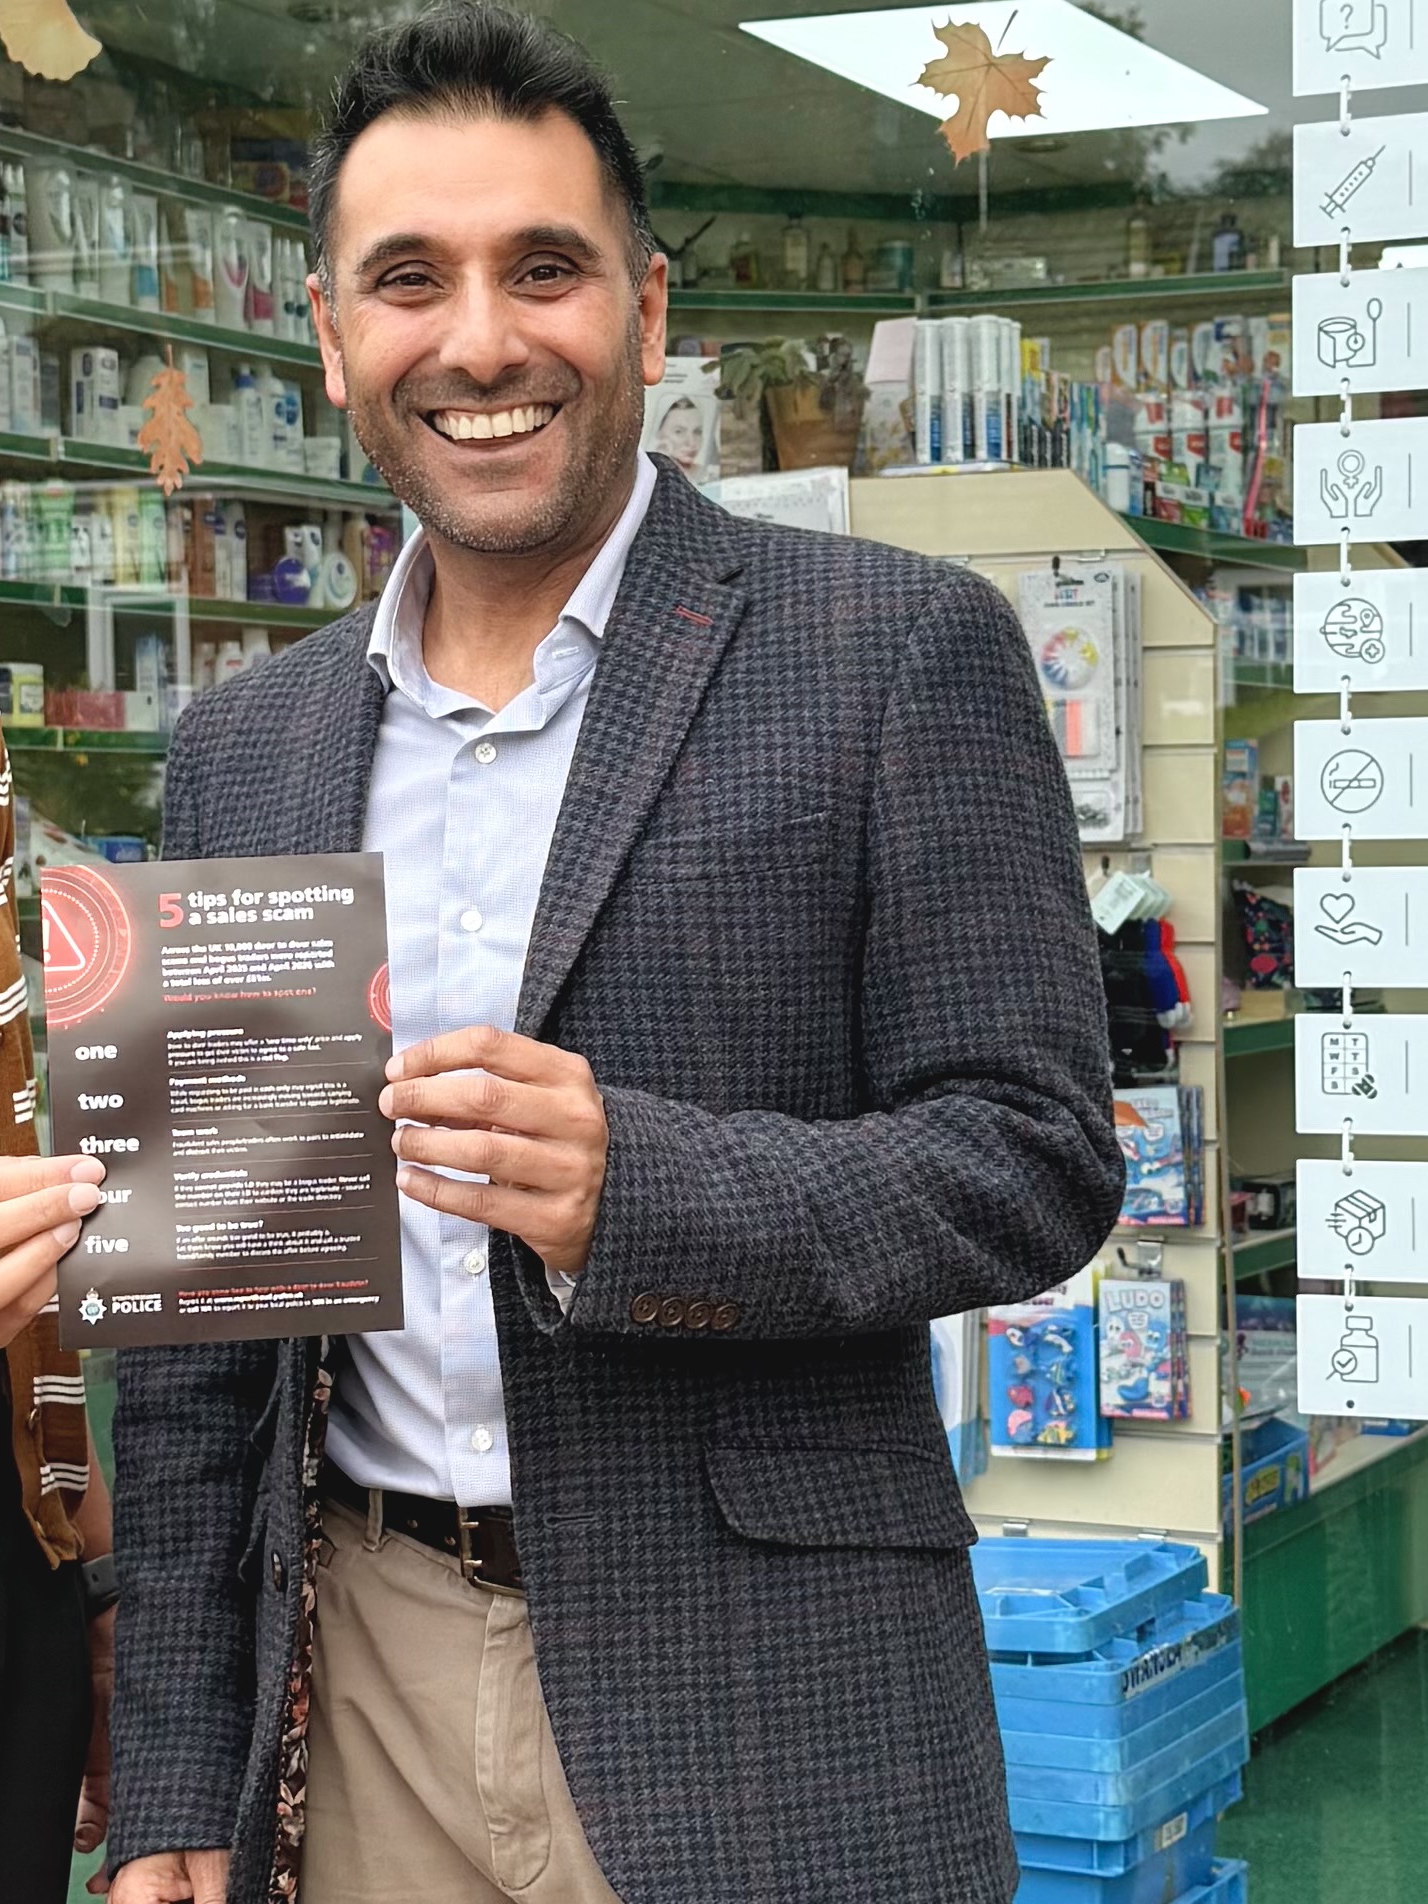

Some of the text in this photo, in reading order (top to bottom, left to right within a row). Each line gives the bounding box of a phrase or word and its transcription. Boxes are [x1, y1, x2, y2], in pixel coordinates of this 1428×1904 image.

[158, 884, 355, 928] 5 tips for spotting
[188, 905, 314, 925] a sales scam
[75, 1044, 118, 1061] one
[77, 1092, 124, 1111] two
[79, 1136, 140, 1155] three
[99, 1188, 133, 1205] our
[85, 1235, 130, 1254] five
[112, 1299, 163, 1315] POLICE
[1104, 1289, 1165, 1313] LUDO
